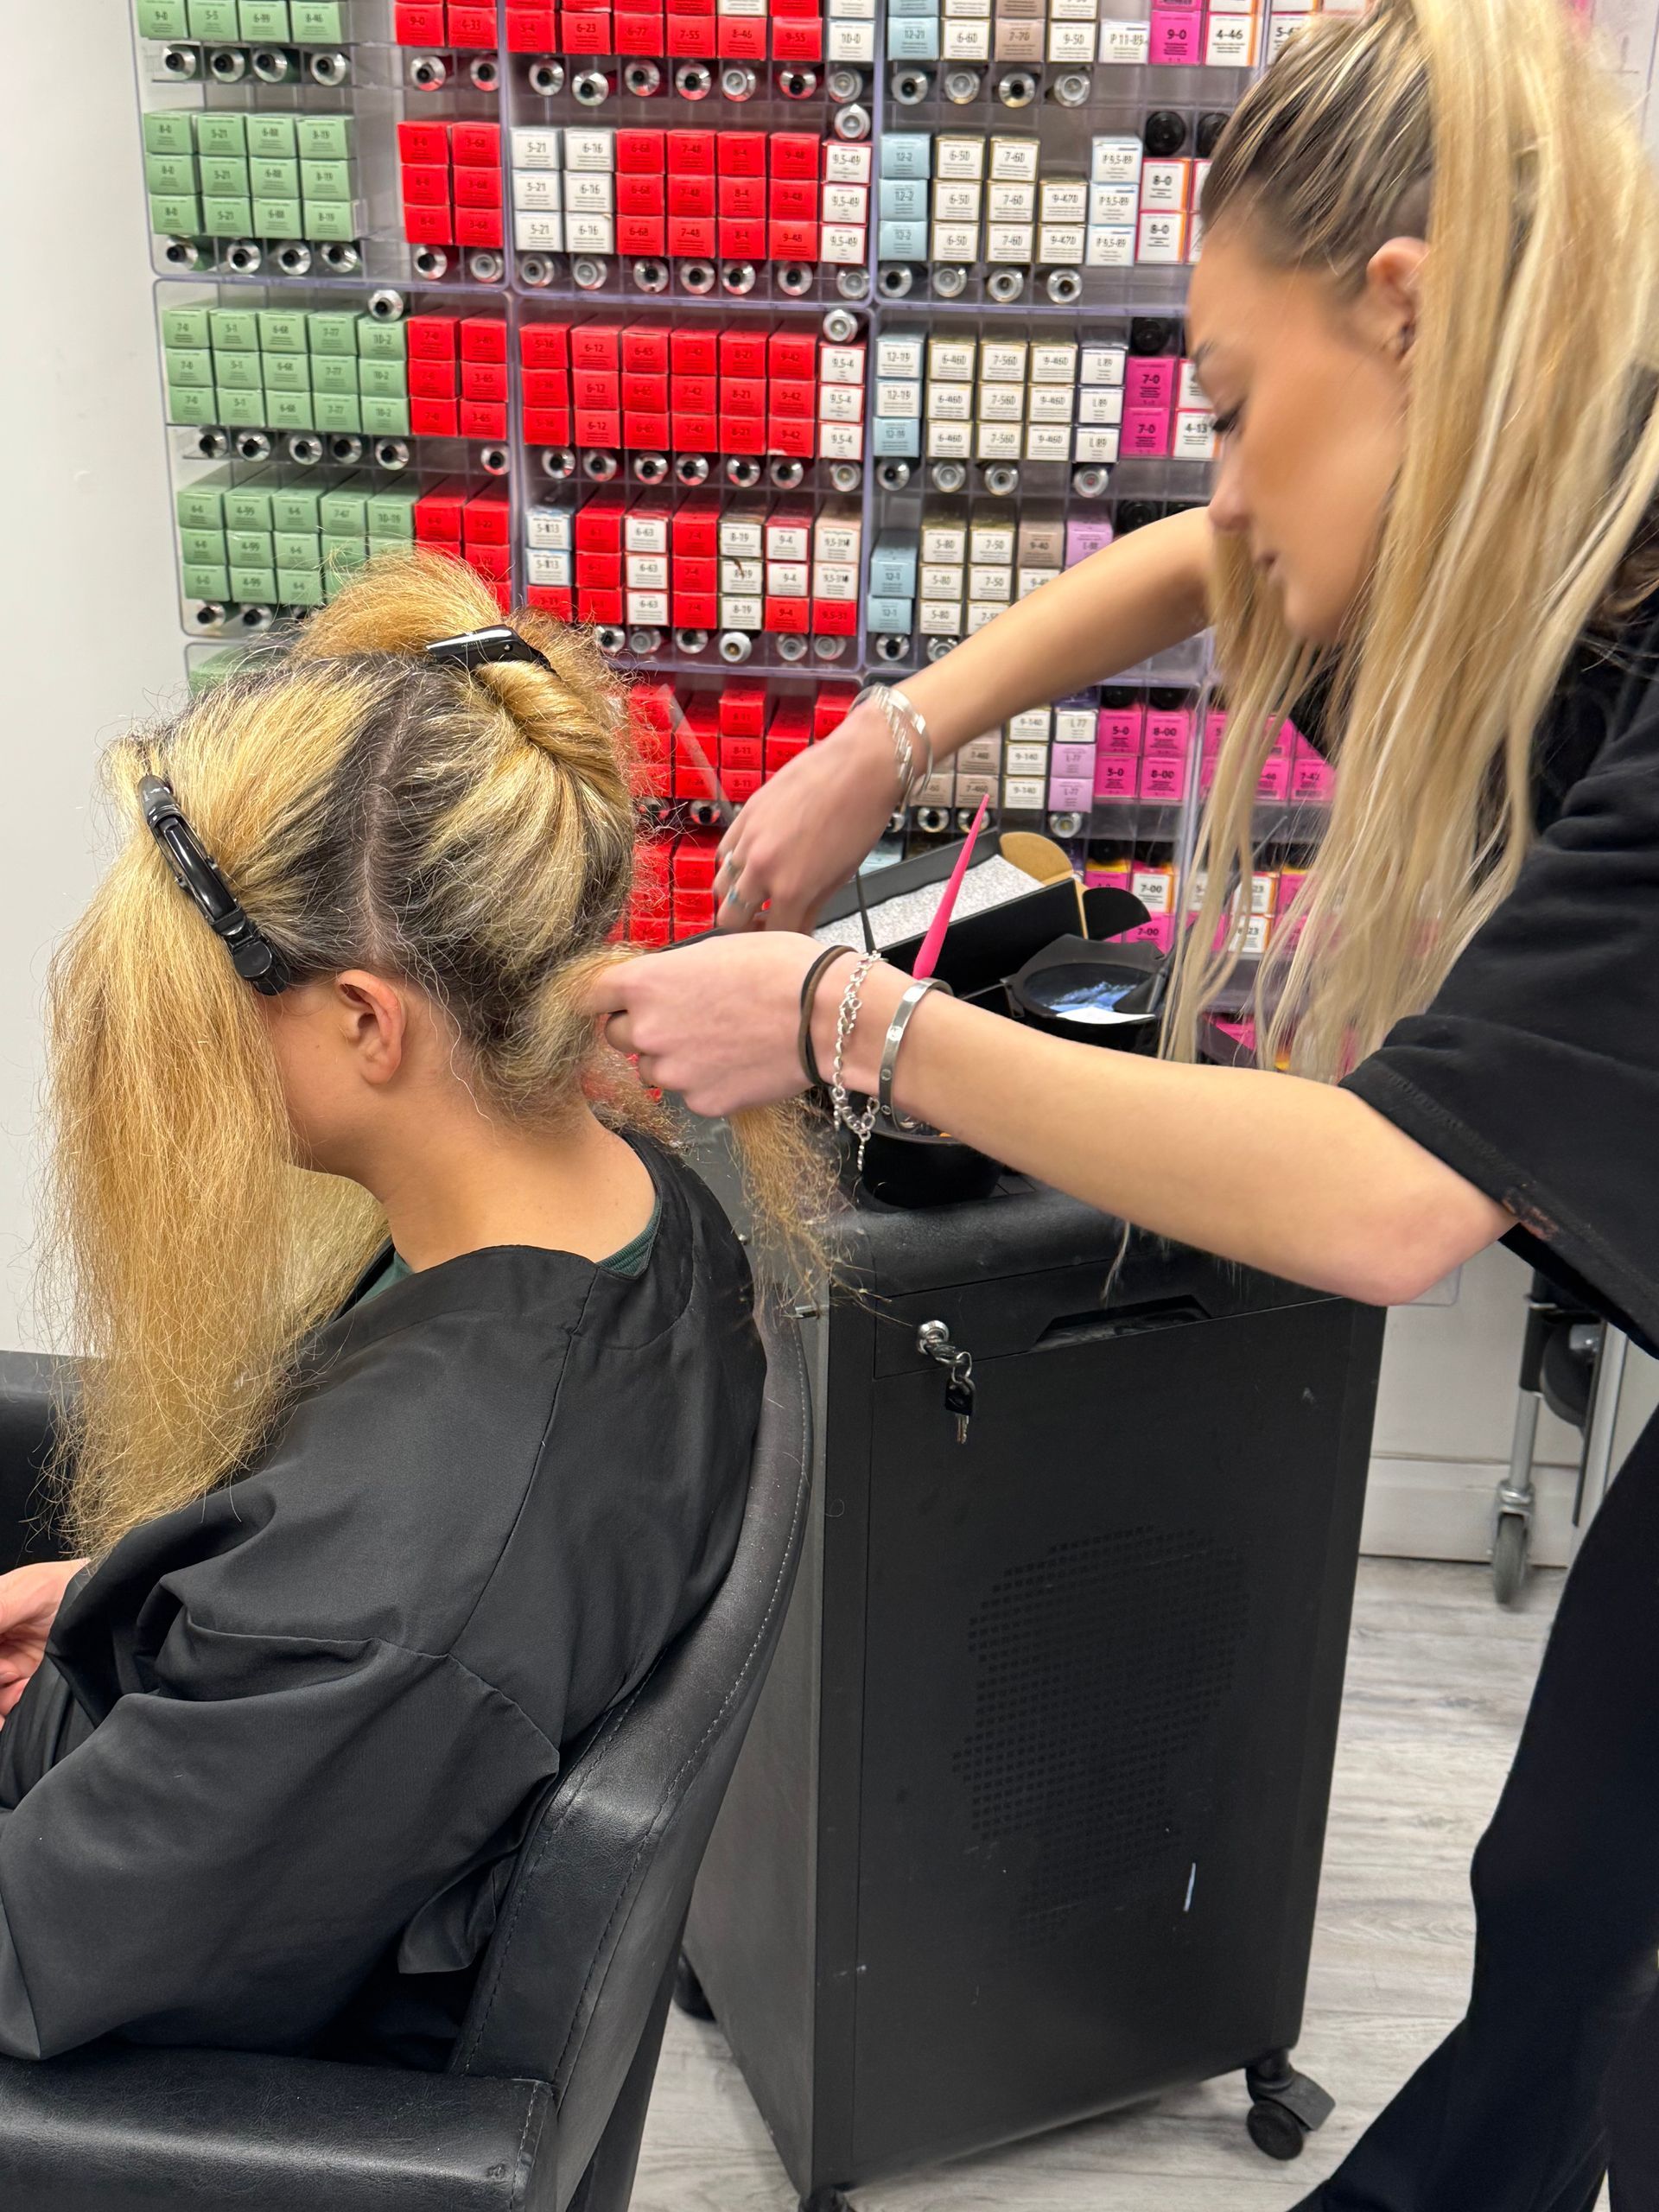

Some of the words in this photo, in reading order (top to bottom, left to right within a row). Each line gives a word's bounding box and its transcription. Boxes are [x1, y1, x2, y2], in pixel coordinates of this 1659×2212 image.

[576, 24, 596, 33] 6-23
[1167, 29, 1186, 40] 9-0
[1216, 29, 1243, 40] 4-46
[1153, 175, 1172, 187] 8-0
[1150, 225, 1168, 235] 8-0
[584, 344, 604, 353] 6-12
[1142, 375, 1160, 384] 7-0
[587, 384, 605, 393] 6-12
[588, 422, 606, 430] 6-12
[1138, 424, 1155, 434] 7-0
[779, 535, 792, 544] 9-4
[784, 573, 797, 582] 9-4
[1112, 726, 1129, 735] 5-0
[1107, 768, 1123, 777] 5-0
[1141, 884, 1162, 893] 7-00
[1137, 927, 1159, 936] 7-00
